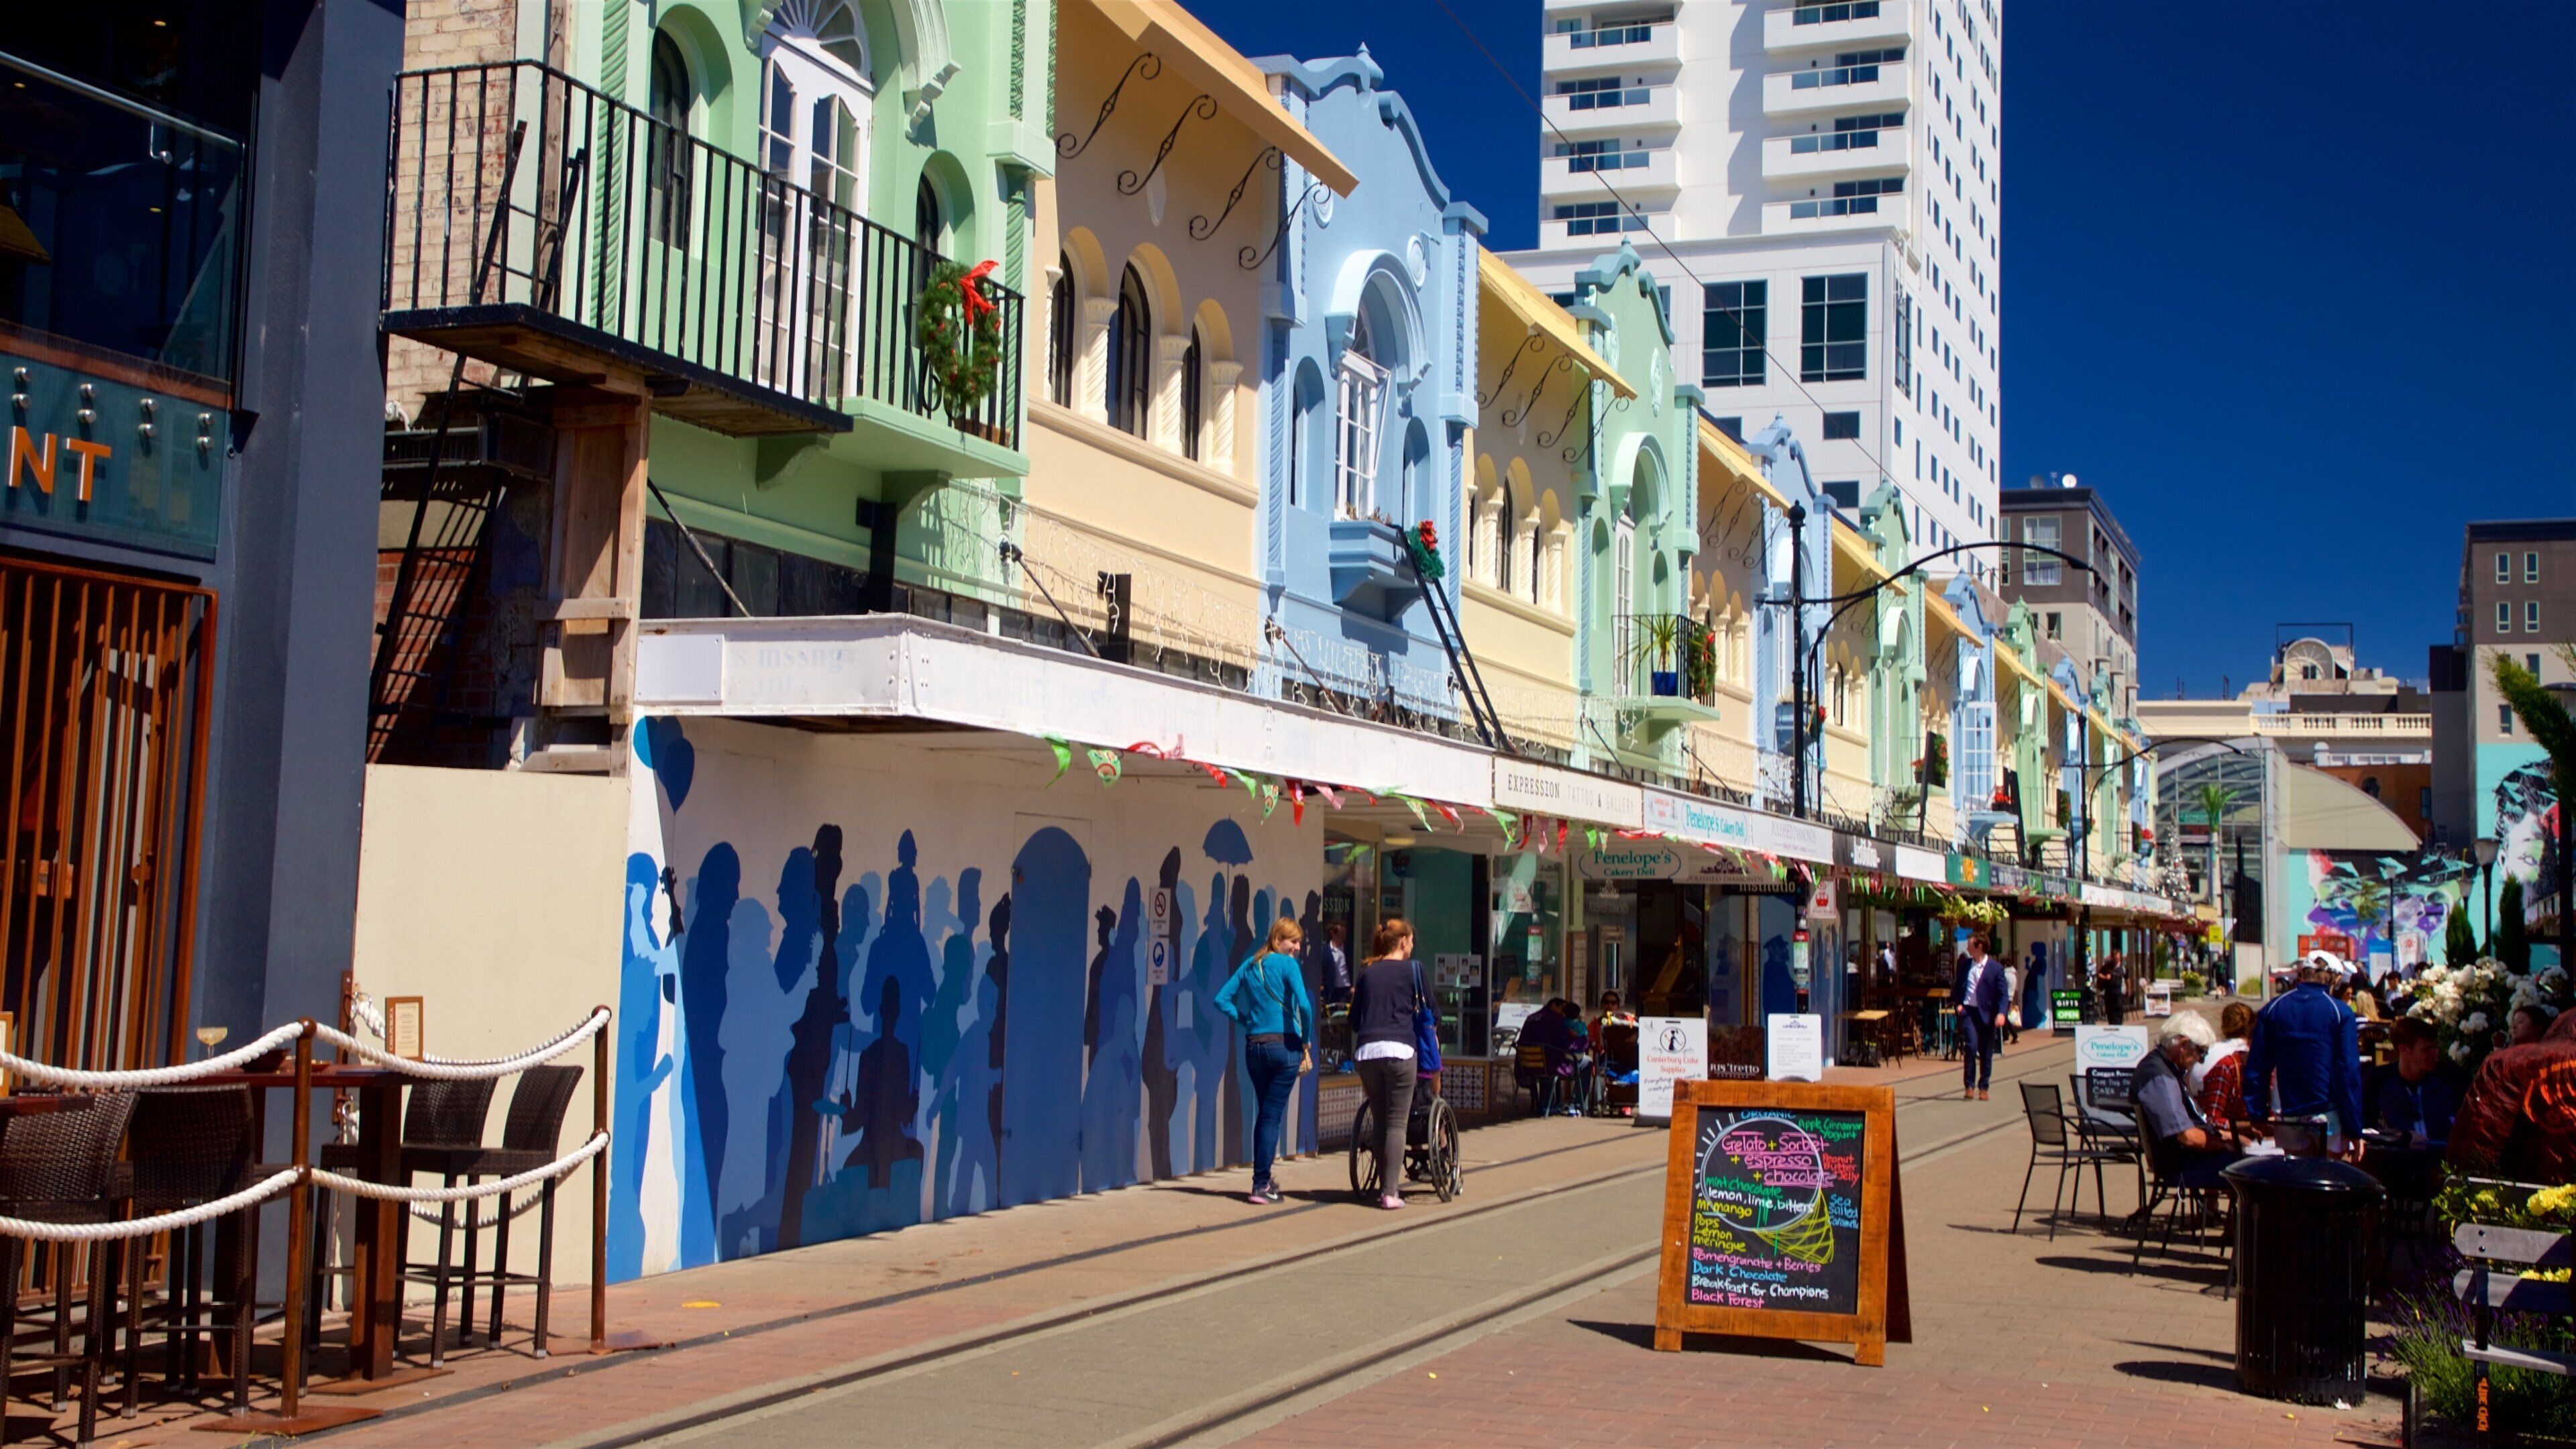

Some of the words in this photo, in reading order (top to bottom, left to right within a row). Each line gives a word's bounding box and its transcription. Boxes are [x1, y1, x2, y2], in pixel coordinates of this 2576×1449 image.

[9, 425, 112, 502] NT
[1508, 774, 1560, 798] EXPRESSION
[1568, 785, 1593, 806] TATTOO
[1606, 794, 1633, 813] GALLERY
[1686, 804, 1719, 838] Penelope's
[1721, 818, 1735, 838] Cakery
[1736, 822, 1744, 837] Deli
[1595, 850, 1671, 868] Penelope's
[1604, 868, 1634, 877] Cakery
[1637, 868, 1656, 876] Deli
[2057, 1010, 2080, 1020] OPEN
[2091, 1041, 2139, 1053] Penelope's
[1647, 1055, 1682, 1065] Canterbury
[1684, 1056, 1699, 1064] Cake
[1660, 1065, 1686, 1075] Supplies
[1740, 1109, 1797, 1120] ORGANIC
[1798, 1117, 1822, 1130] Apple
[1823, 1117, 1863, 1130] Cinnamon
[1722, 1135, 1767, 1152] Gelato
[1778, 1136, 1830, 1151] Sorbet
[1744, 1154, 1812, 1171] espresso
[1764, 1169, 1837, 1183] chocolate
[1705, 1176, 1728, 1188] mint
[1729, 1179, 1782, 1197] chocolate
[1830, 1193, 1851, 1206] Sea
[1695, 1212, 1720, 1229] Pops
[1695, 1224, 1732, 1240] Lemon
[1693, 1235, 1747, 1254] meringue
[1693, 1259, 1724, 1275] Dark
[1729, 1265, 1788, 1283] Chocolate
[1784, 1256, 1822, 1273] Berries
[1691, 1274, 1747, 1295] Breakfast
[1750, 1282, 1766, 1297] for
[1769, 1284, 1829, 1301] Champions
[1691, 1288, 1724, 1303] Black
[1727, 1293, 1765, 1309] Forest
